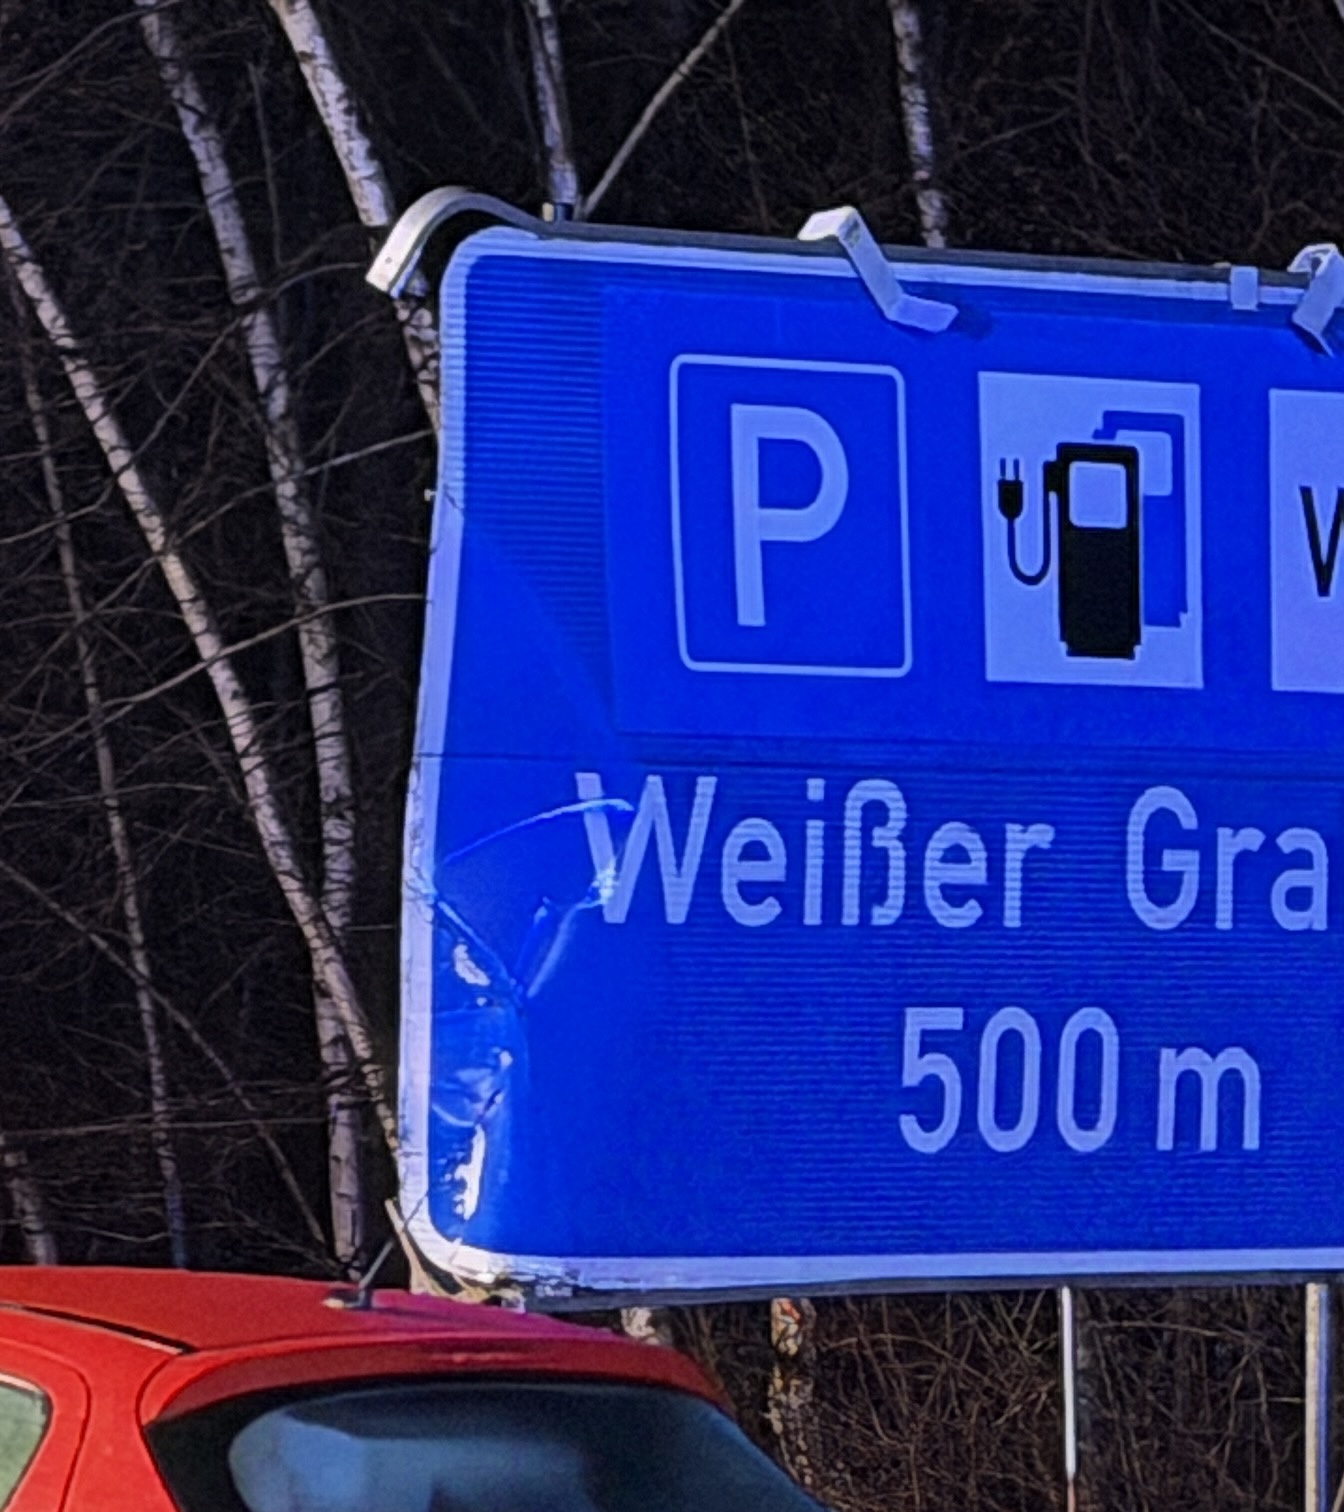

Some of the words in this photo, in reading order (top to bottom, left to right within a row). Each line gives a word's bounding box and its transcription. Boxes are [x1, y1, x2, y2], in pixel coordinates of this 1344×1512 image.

[729, 403, 849, 627] P
[575, 772, 1055, 928] Weißer
[898, 1006, 1119, 1153] 500
[1156, 1042, 1261, 1150] m
